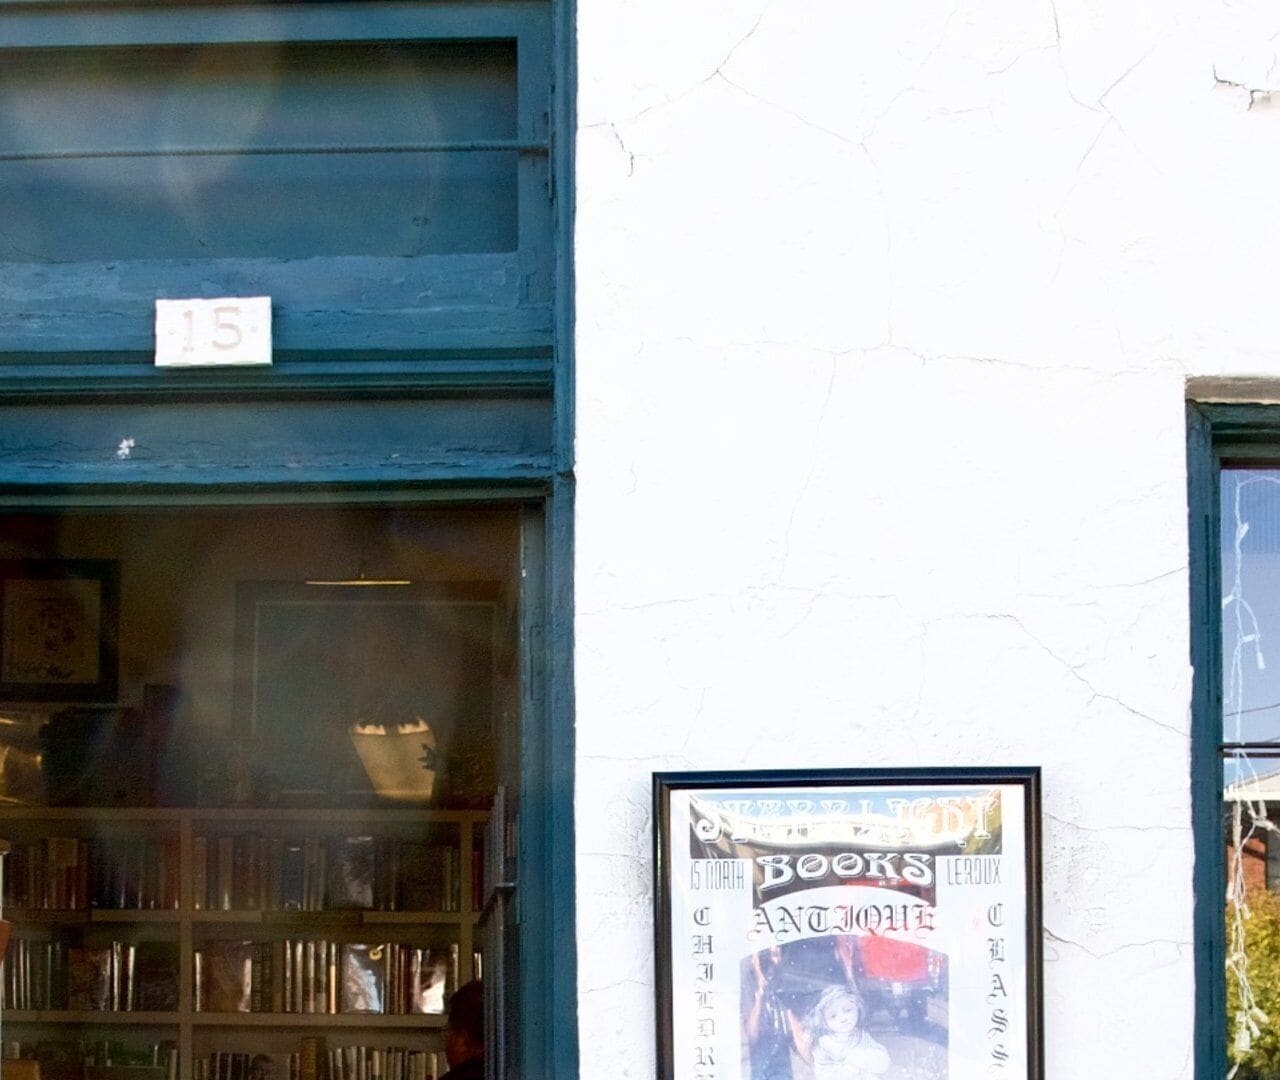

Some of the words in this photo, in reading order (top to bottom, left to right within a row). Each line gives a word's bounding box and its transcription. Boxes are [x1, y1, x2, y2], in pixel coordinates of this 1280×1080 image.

[183, 307, 243, 352] 15
[690, 861, 701, 890] 15
[706, 860, 744, 889] NORTH
[947, 857, 1002, 885] LEROUX
[756, 852, 935, 889] BOOKS
[749, 904, 937, 941] ANTIQUE
